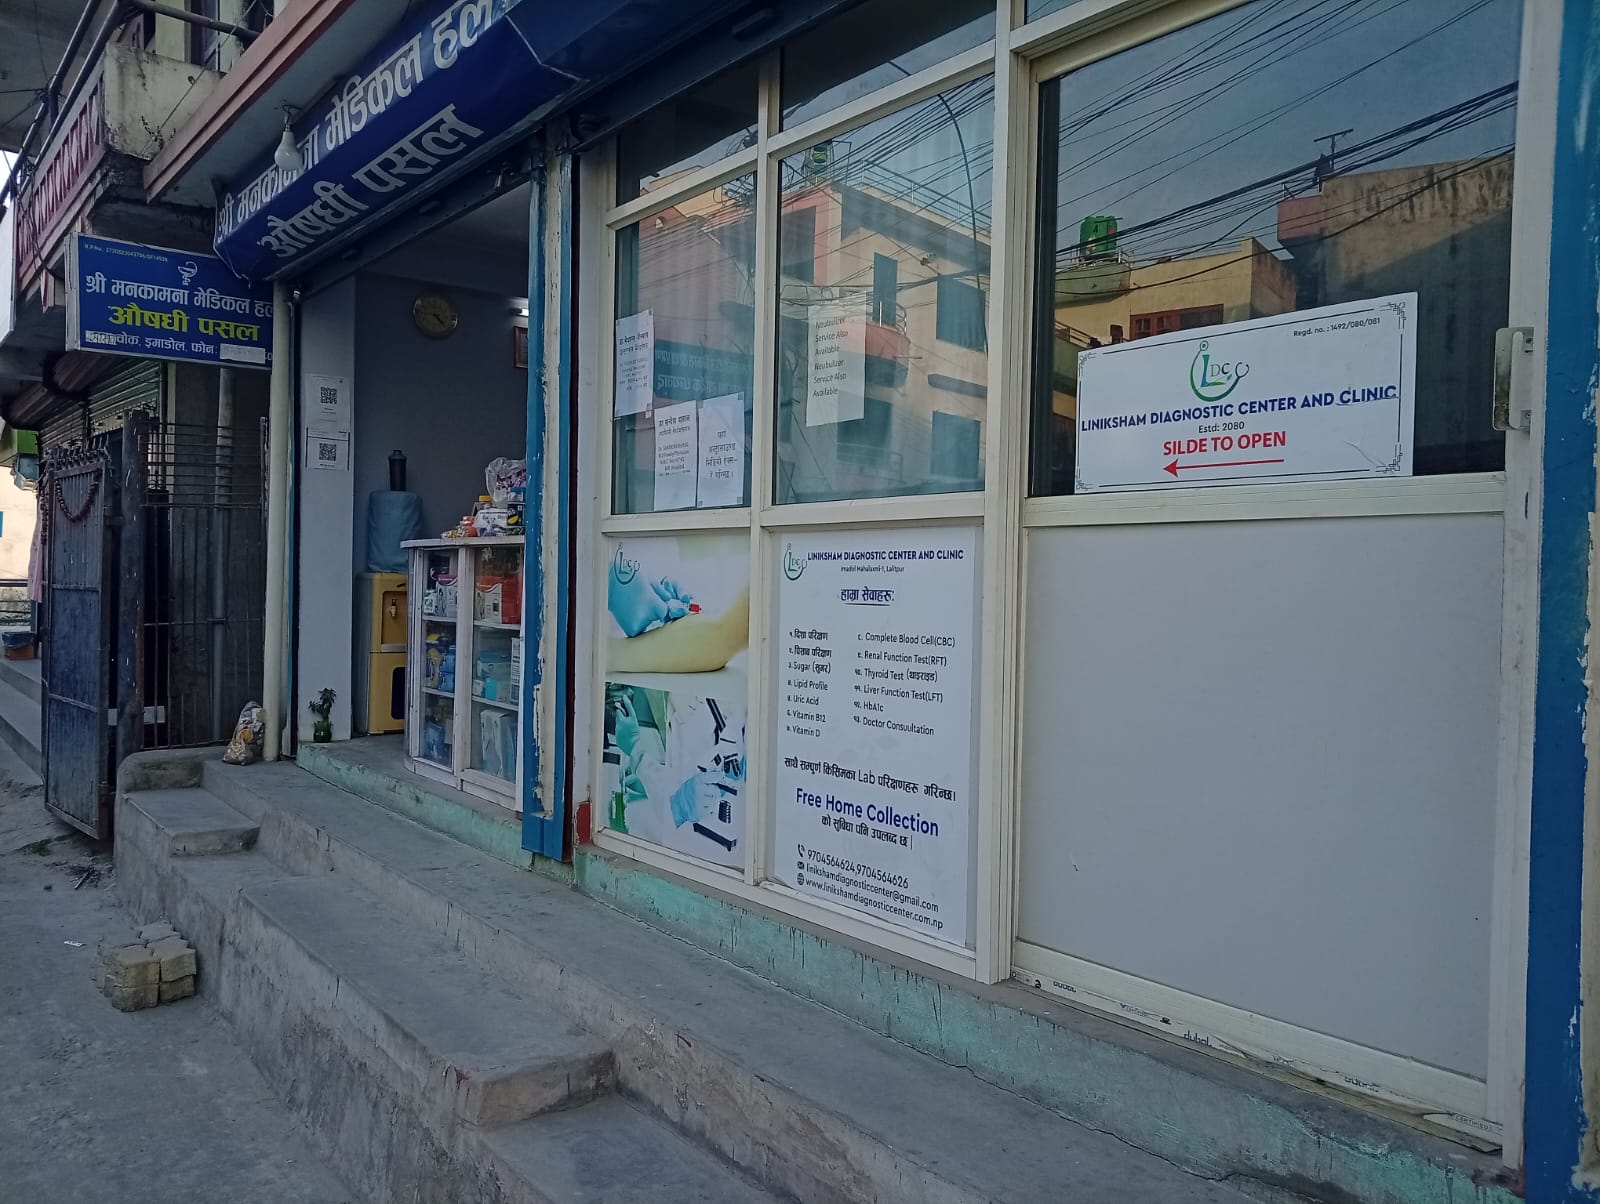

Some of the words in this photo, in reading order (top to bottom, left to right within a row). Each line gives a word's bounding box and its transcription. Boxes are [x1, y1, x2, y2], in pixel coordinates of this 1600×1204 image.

[325, 32, 424, 150] मेडिकल
[256, 180, 369, 258] औषधी
[352, 103, 484, 193] पसल
[85, 271, 107, 294] श्री
[111, 279, 189, 305] मनकामना
[193, 287, 250, 314] मेडिकल
[108, 302, 190, 333] औषधी
[197, 317, 260, 342] पसल
[835, 330, 849, 339] Also
[1293, 327, 1313, 337] Regd.
[834, 371, 847, 381] Also
[1081, 413, 1147, 432] LINIKSHAM
[1150, 403, 1234, 424] DIAGNOSTIC
[1238, 396, 1297, 416] CENTER
[1300, 392, 1335, 409] AND
[1339, 385, 1398, 405] CLINIC
[1198, 423, 1220, 433] Estd:
[1222, 420, 1245, 432] 2080
[1163, 438, 1207, 456] SILDE
[1210, 435, 1234, 451] TO
[1237, 431, 1287, 449] OPEN
[807, 551, 843, 561] LINIKSHAM
[843, 551, 887, 561] DIAGNOSTIC
[888, 550, 917, 560] CENTER
[918, 550, 935, 560] AND
[936, 549, 964, 560] CLINIC
[865, 632, 897, 645] Complete
[899, 634, 919, 645] Blood
[864, 650, 883, 661] Renal
[884, 651, 913, 664] Function
[793, 660, 811, 673] Sugar
[864, 668, 889, 680] Thyroid
[890, 670, 904, 681] Test
[793, 679, 808, 689] Lipid
[809, 680, 829, 691] Profile
[863, 684, 880, 695] Liver
[881, 687, 910, 699] Function
[793, 694, 805, 703] Uric
[805, 696, 819, 706] Acid
[863, 701, 884, 712] HbA1c
[792, 709, 815, 721] Vitamin
[815, 712, 826, 723] B12
[863, 716, 886, 729] Doctor
[792, 724, 815, 736] Vitamin
[815, 728, 821, 738] D
[858, 769, 876, 785] Lab
[796, 787, 822, 809] Free
[826, 794, 863, 818] Home
[866, 803, 939, 837] Collection
[821, 814, 832, 827] को
[855, 821, 869, 838] पनि
[807, 849, 909, 890] 9704564624,9704564626
[806, 862, 939, 913] linikshamdiagnosticcenter@gmail.com
[805, 878, 944, 931] www.linikshamdiagnosticcenter.com.np
